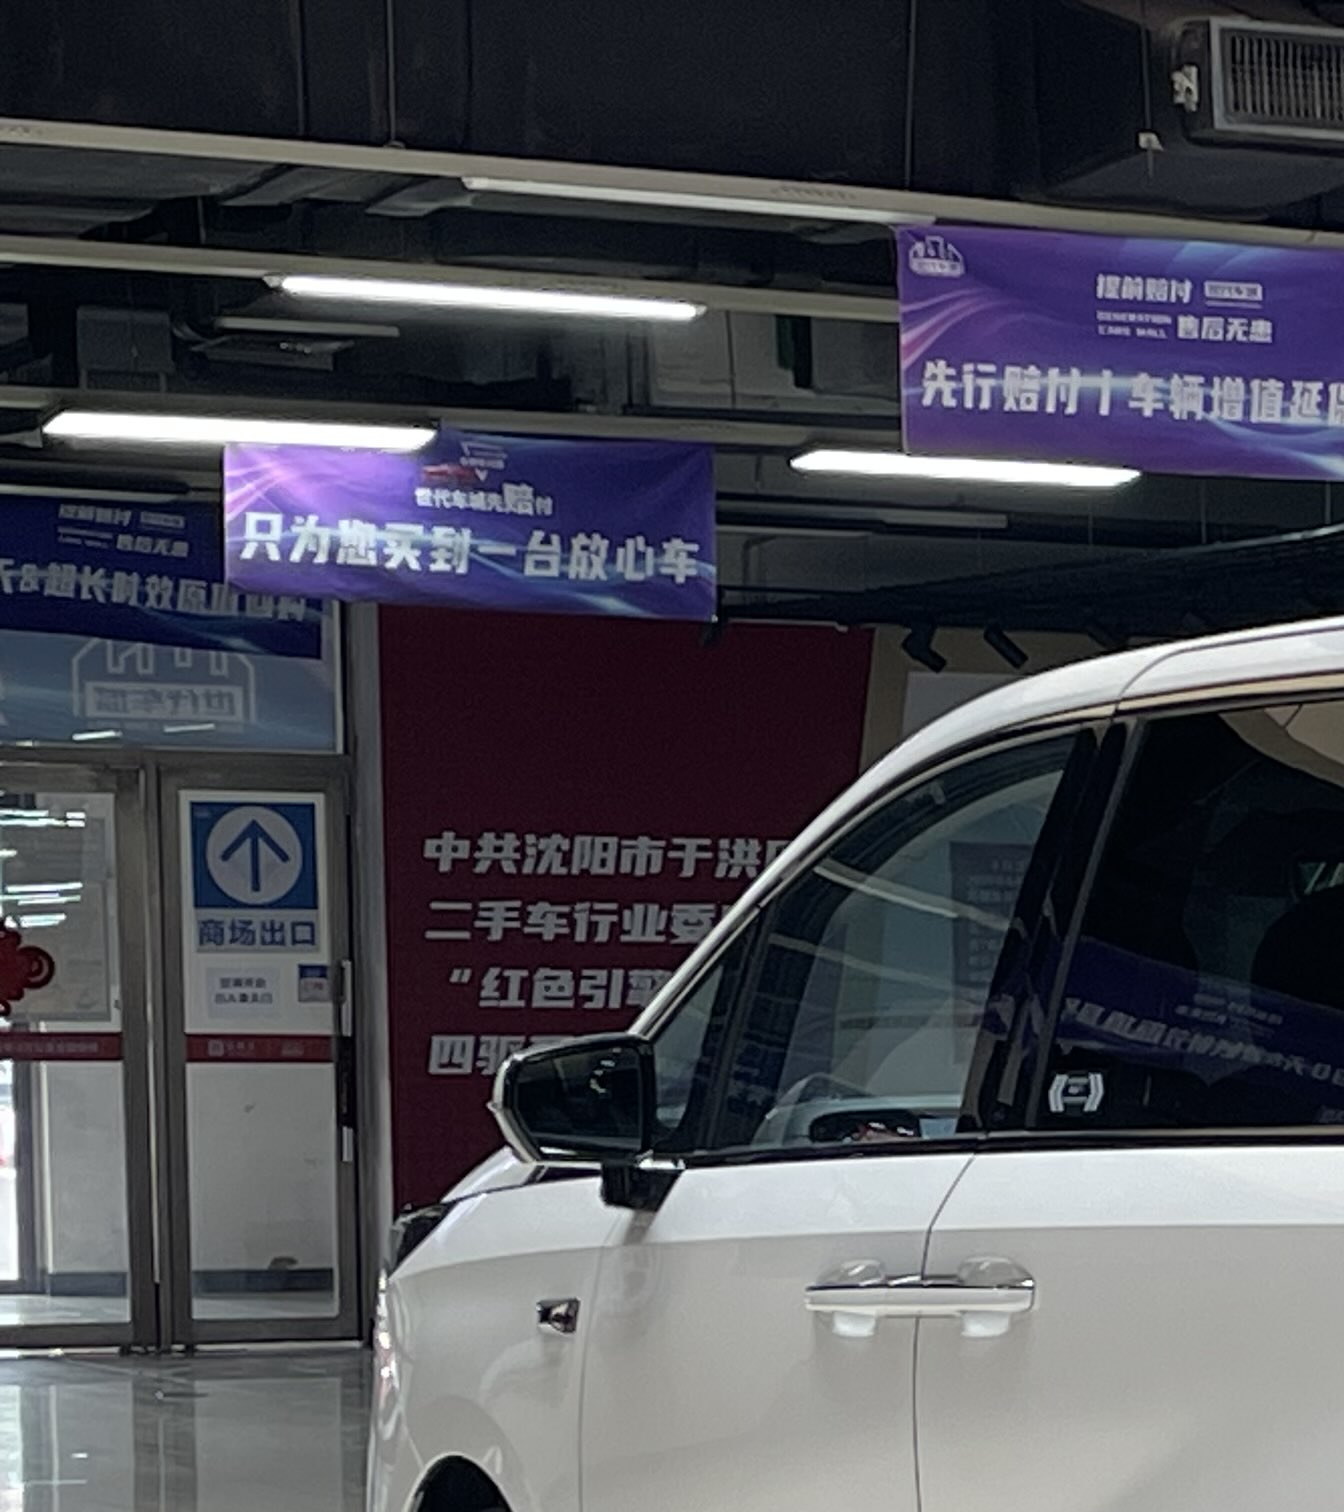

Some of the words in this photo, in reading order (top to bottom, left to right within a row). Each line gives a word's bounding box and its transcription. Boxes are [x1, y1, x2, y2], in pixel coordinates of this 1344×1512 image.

[240, 510, 701, 585] 只为您买到一台放心车
[199, 917, 317, 948] 商场出口
[425, 899, 735, 945] 二手车行业委
